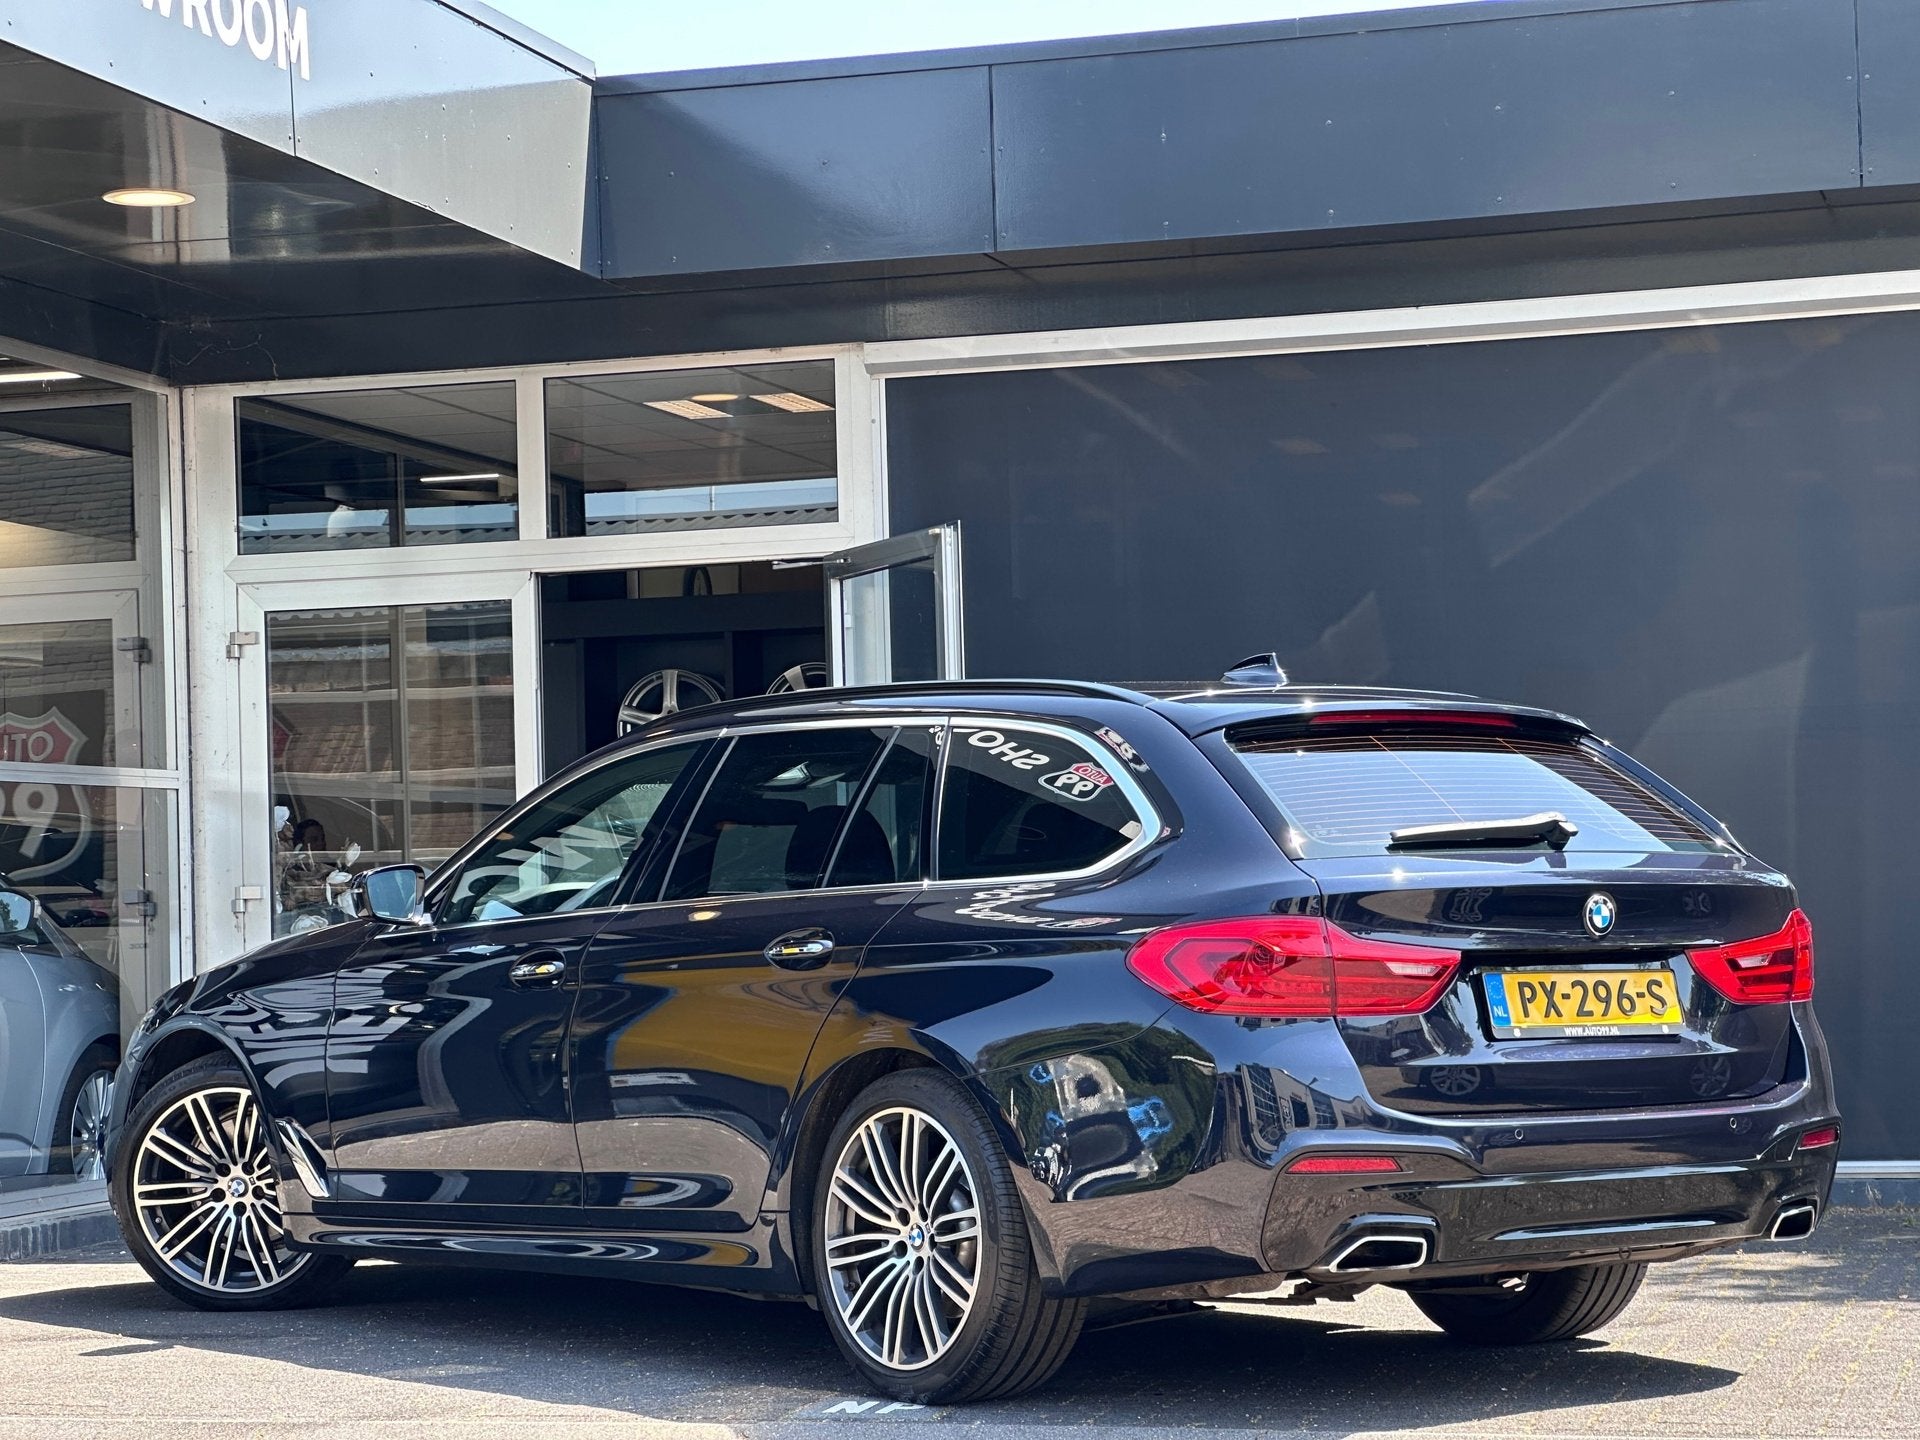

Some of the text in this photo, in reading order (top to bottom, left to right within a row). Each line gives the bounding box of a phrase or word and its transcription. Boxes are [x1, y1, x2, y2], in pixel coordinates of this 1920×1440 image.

[142, 0, 310, 81] OOM
[0, 782, 59, 860] 9
[1493, 1006, 1508, 1018] NL
[1517, 979, 1667, 1019] PX-296-S
[1563, 1025, 1620, 1037] WWW.AUTO99.NL
